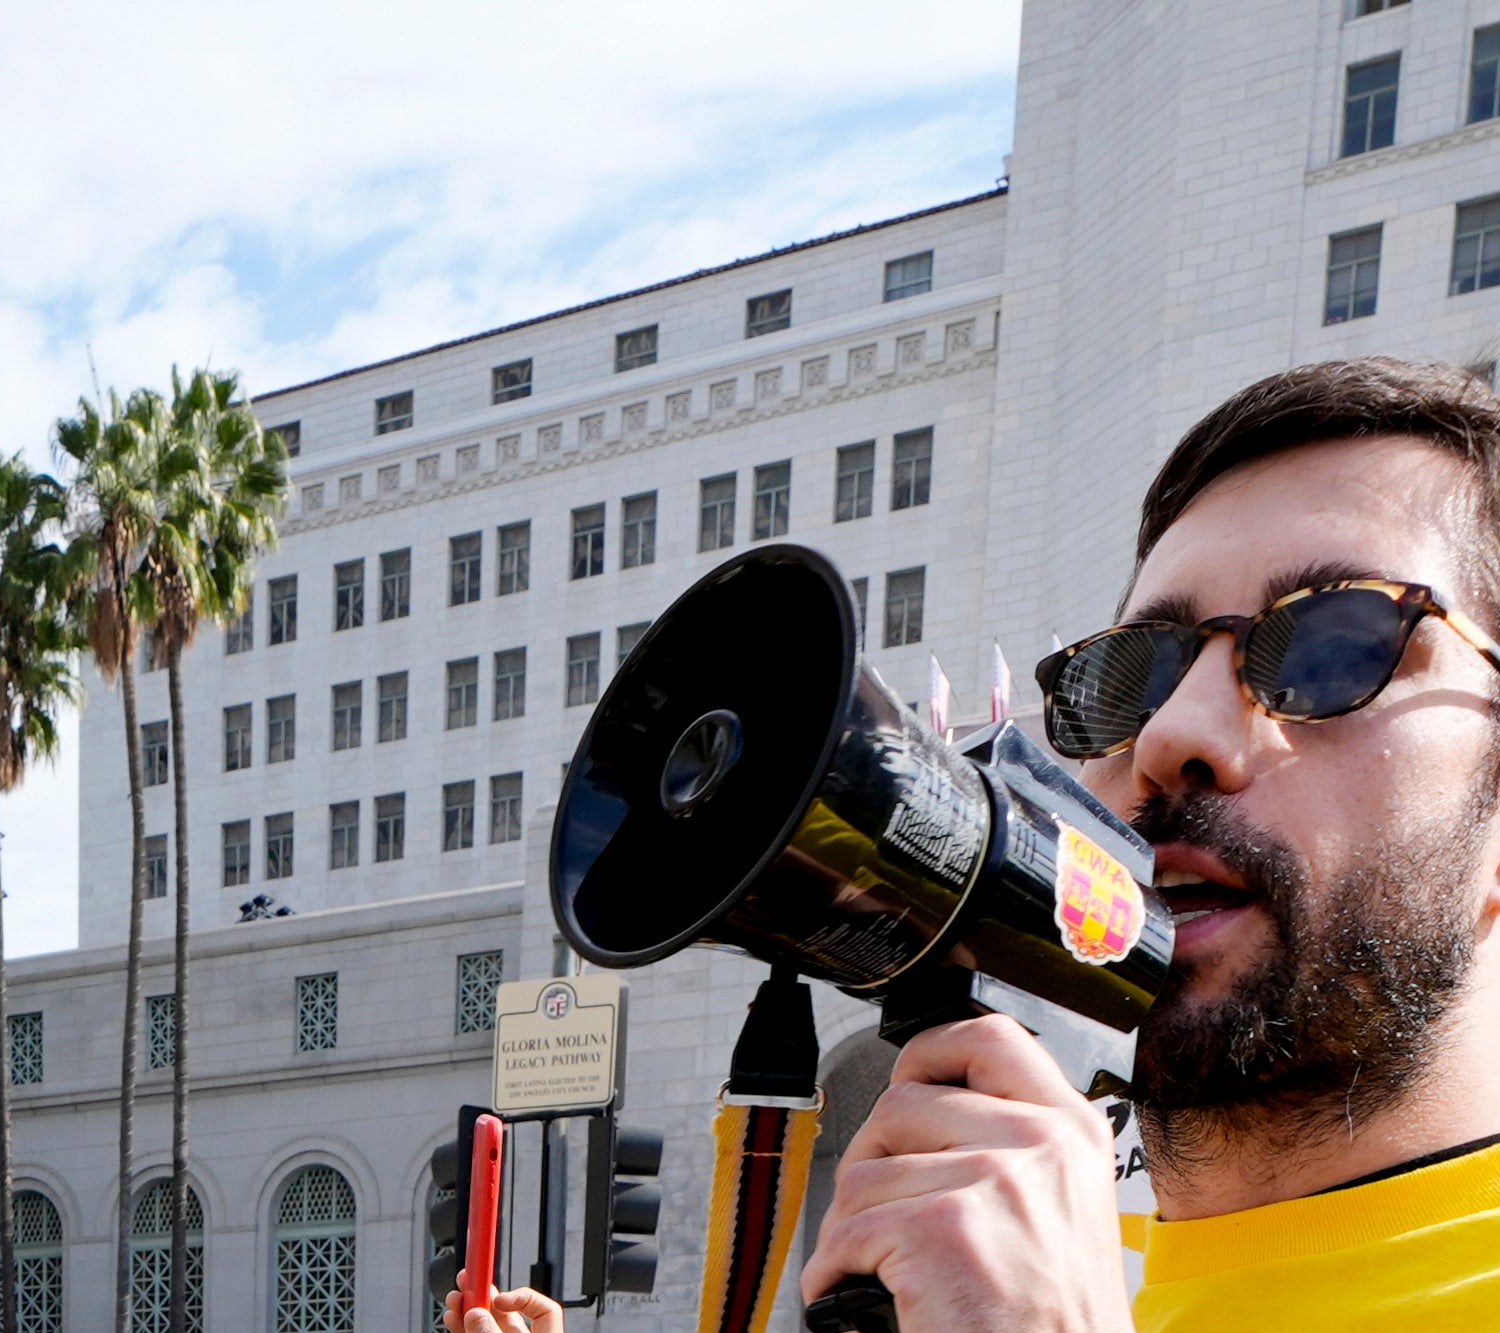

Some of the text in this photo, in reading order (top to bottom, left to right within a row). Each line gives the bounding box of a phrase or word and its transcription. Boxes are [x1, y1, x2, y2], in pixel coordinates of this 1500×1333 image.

[501, 1033, 608, 1053] GLORIA MOLINA
[505, 1052, 603, 1070] LEGACY PATHWAY
[523, 1088, 550, 1097] ANGELES
[606, 1295, 626, 1305] ITY
